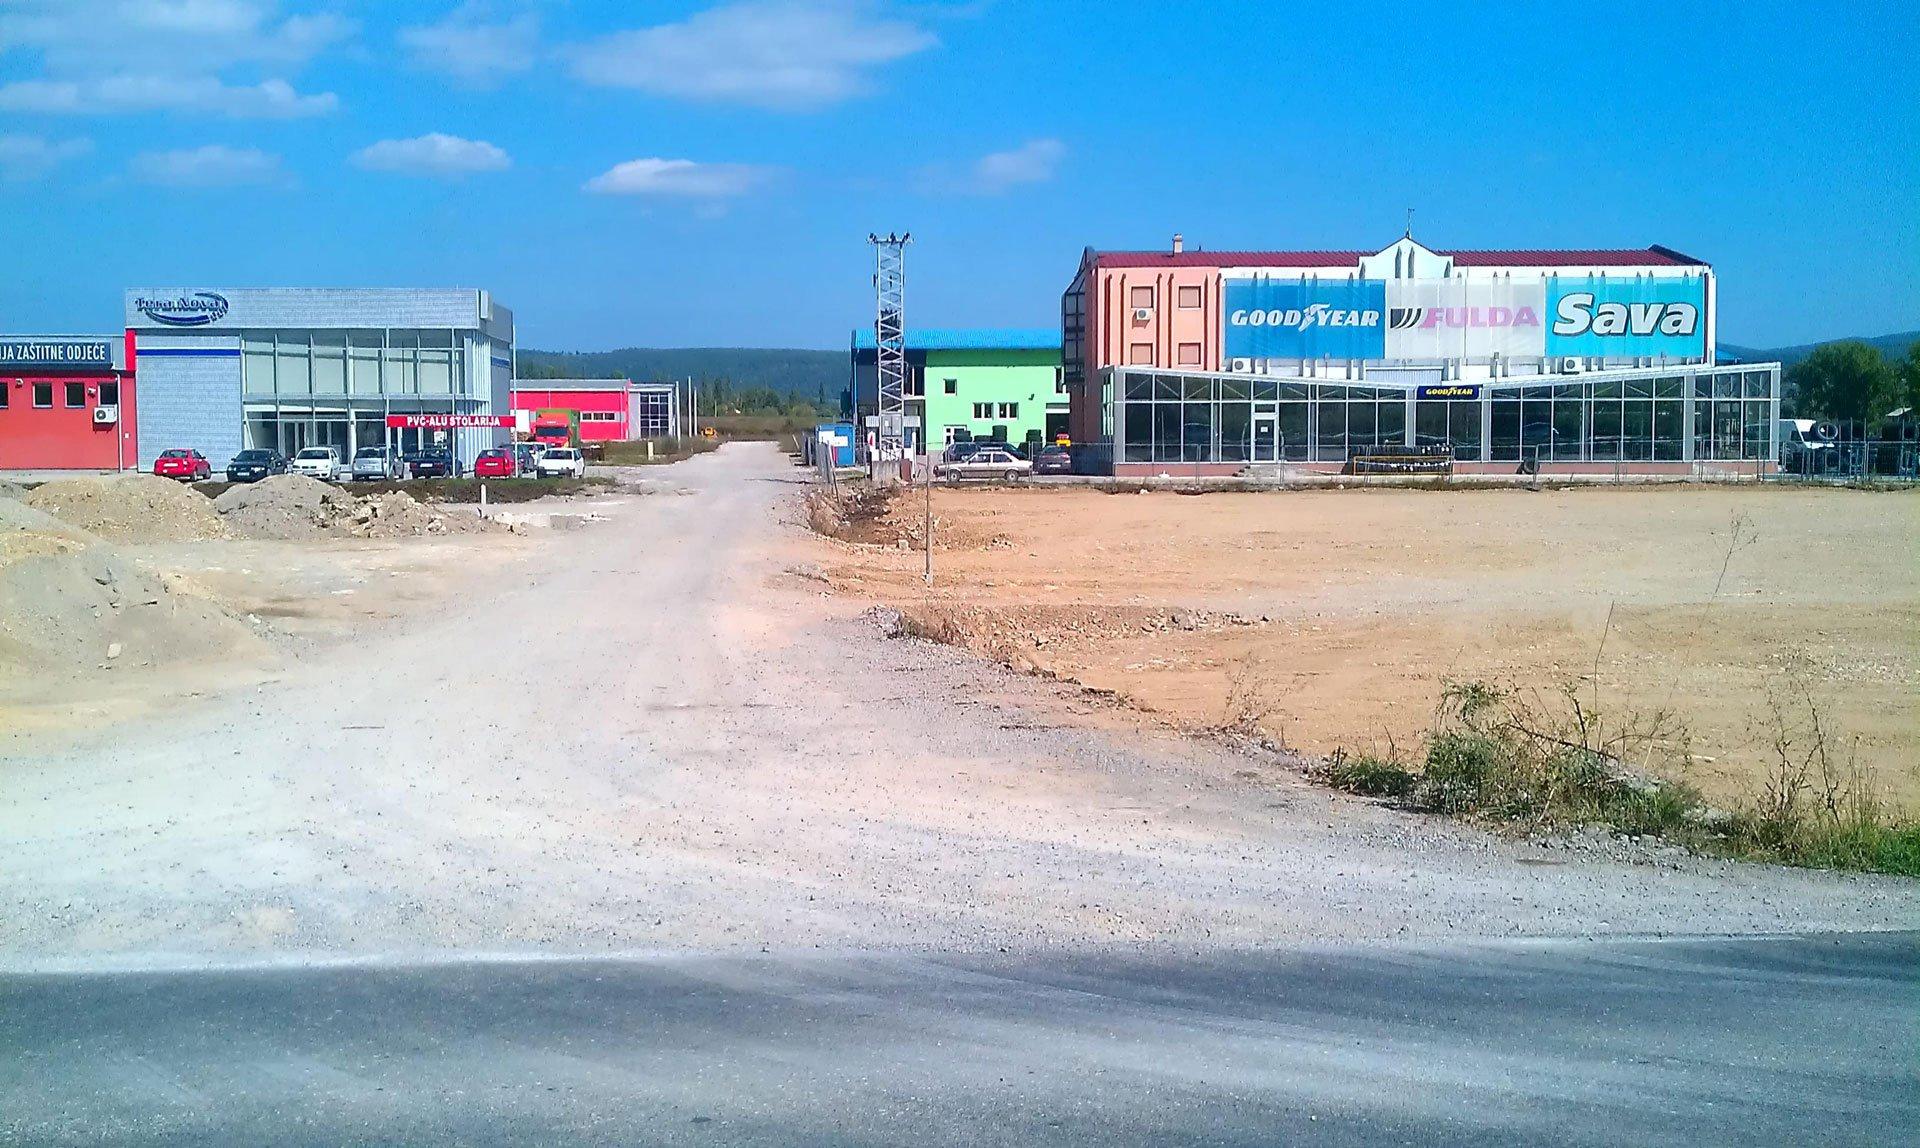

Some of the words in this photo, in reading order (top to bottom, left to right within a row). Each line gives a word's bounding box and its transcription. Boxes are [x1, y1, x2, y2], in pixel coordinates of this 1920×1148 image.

[1231, 303, 1379, 332] GOODYEAR
[1419, 305, 1540, 329] FULDA
[1552, 292, 1697, 336] Sava
[16, 342, 63, 360] ZAŠTITNE
[66, 342, 105, 360] ODJEĆE
[1425, 386, 1473, 396] GOODYEAR
[449, 416, 500, 427] STOLARIJA
